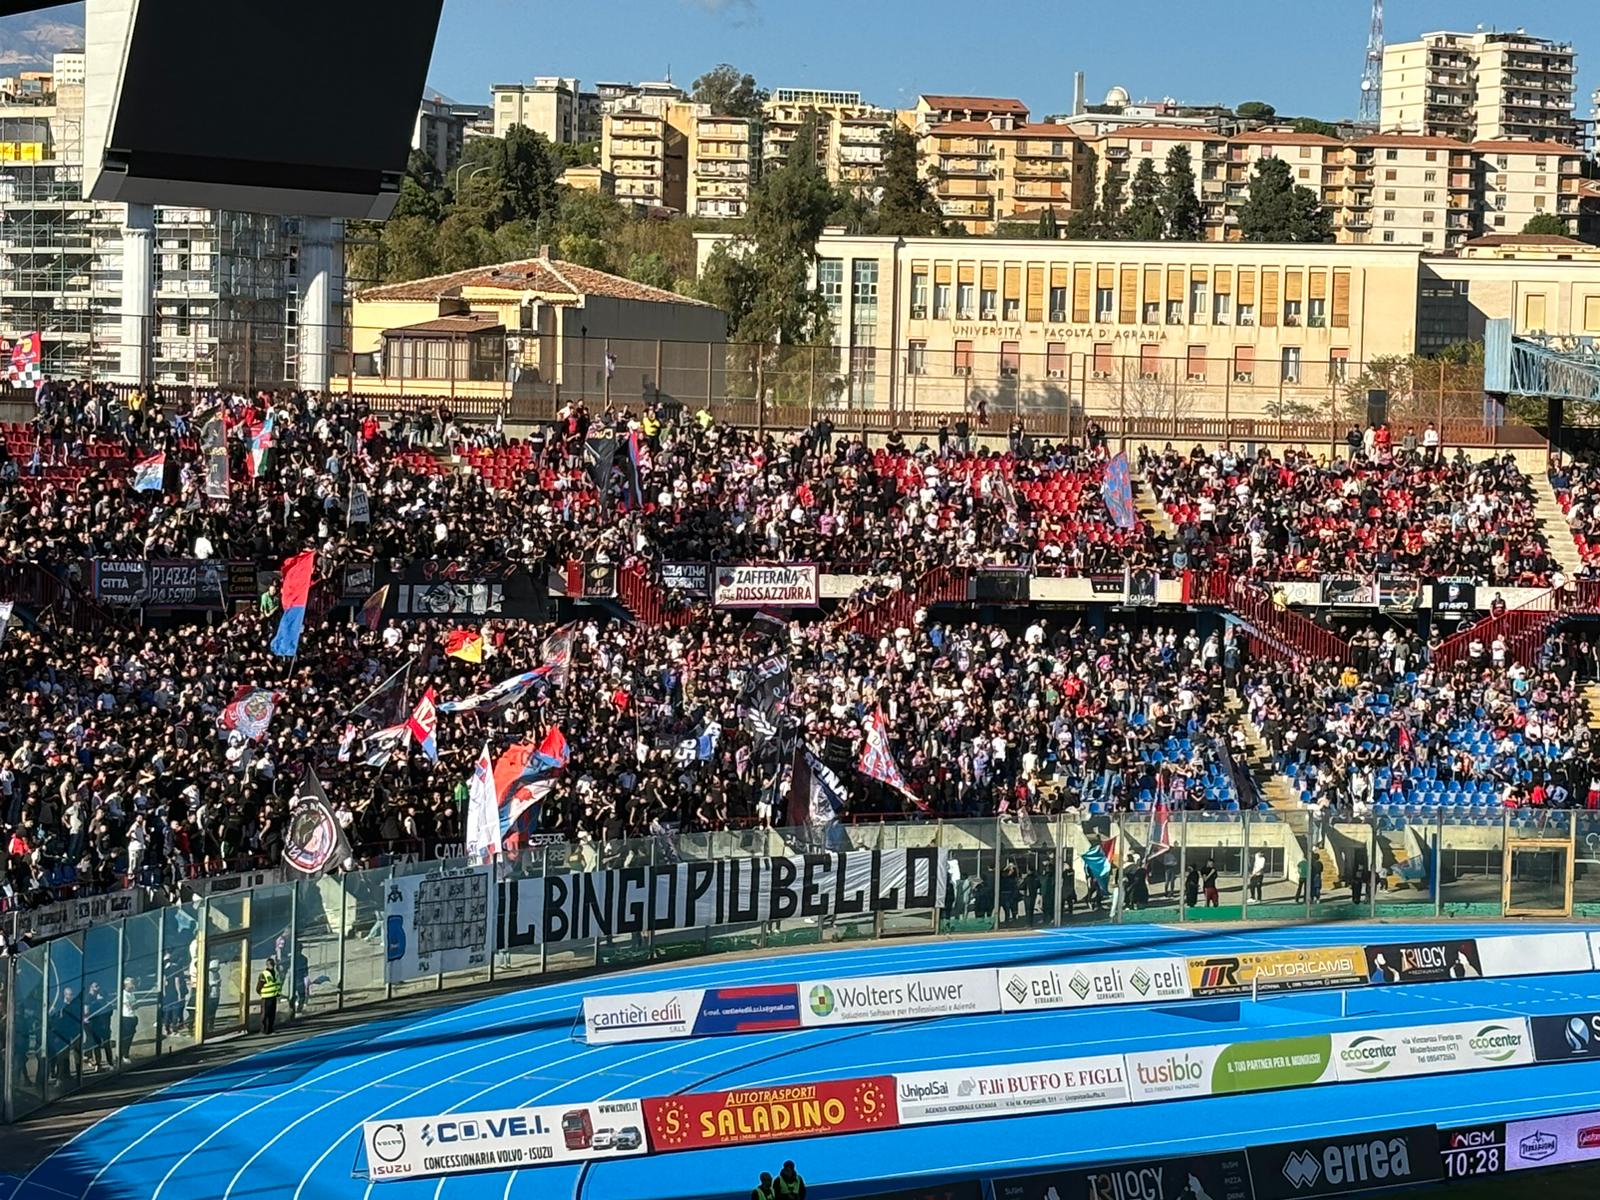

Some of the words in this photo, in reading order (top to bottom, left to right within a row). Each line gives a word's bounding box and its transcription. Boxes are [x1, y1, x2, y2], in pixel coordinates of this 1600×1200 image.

[1115, 330, 1167, 340] AGRARIA
[101, 562, 143, 572] CATANIA
[152, 567, 197, 585] PIAZZA
[736, 568, 798, 585] ZAFFERANA
[101, 576, 129, 588] CITTÀ
[736, 586, 812, 600] ROSSAZZURRA
[542, 864, 677, 943] BINGO
[770, 847, 938, 920] BELLO
[1255, 958, 1354, 978] AUTORICAMBI
[1400, 946, 1447, 972] TRILOGY
[1032, 970, 1062, 996] celi
[1094, 967, 1123, 992] celi
[1154, 963, 1183, 988] celi
[836, 987, 903, 1008] Wolters
[907, 981, 964, 1001] Kluwer
[1469, 1033, 1522, 1050] ecocenter
[1340, 1045, 1398, 1061] ecocenter
[1234, 1061, 1247, 1072] TUO
[1247, 1058, 1273, 1071] PARTNER
[1273, 1057, 1285, 1068] PER
[1008, 1072, 1061, 1093] BUFFO
[1065, 1072, 1076, 1087] E
[1079, 1067, 1124, 1085] FIGLI
[900, 1081, 949, 1101] UnipolSai
[865, 1090, 876, 1114] S
[666, 1110, 680, 1134] S
[700, 1099, 846, 1138] SALADINO
[377, 1138, 402, 1146] VOLVO
[1453, 1130, 1496, 1148] NGM
[424, 1151, 496, 1170] CONCESSIONARIA
[496, 1150, 523, 1163] VOLVO
[529, 1146, 553, 1161] ISUZU
[1222, 1160, 1239, 1170] SUSHI
[1445, 1148, 1499, 1177] 10:28
[373, 1163, 412, 1175] ISUZU
